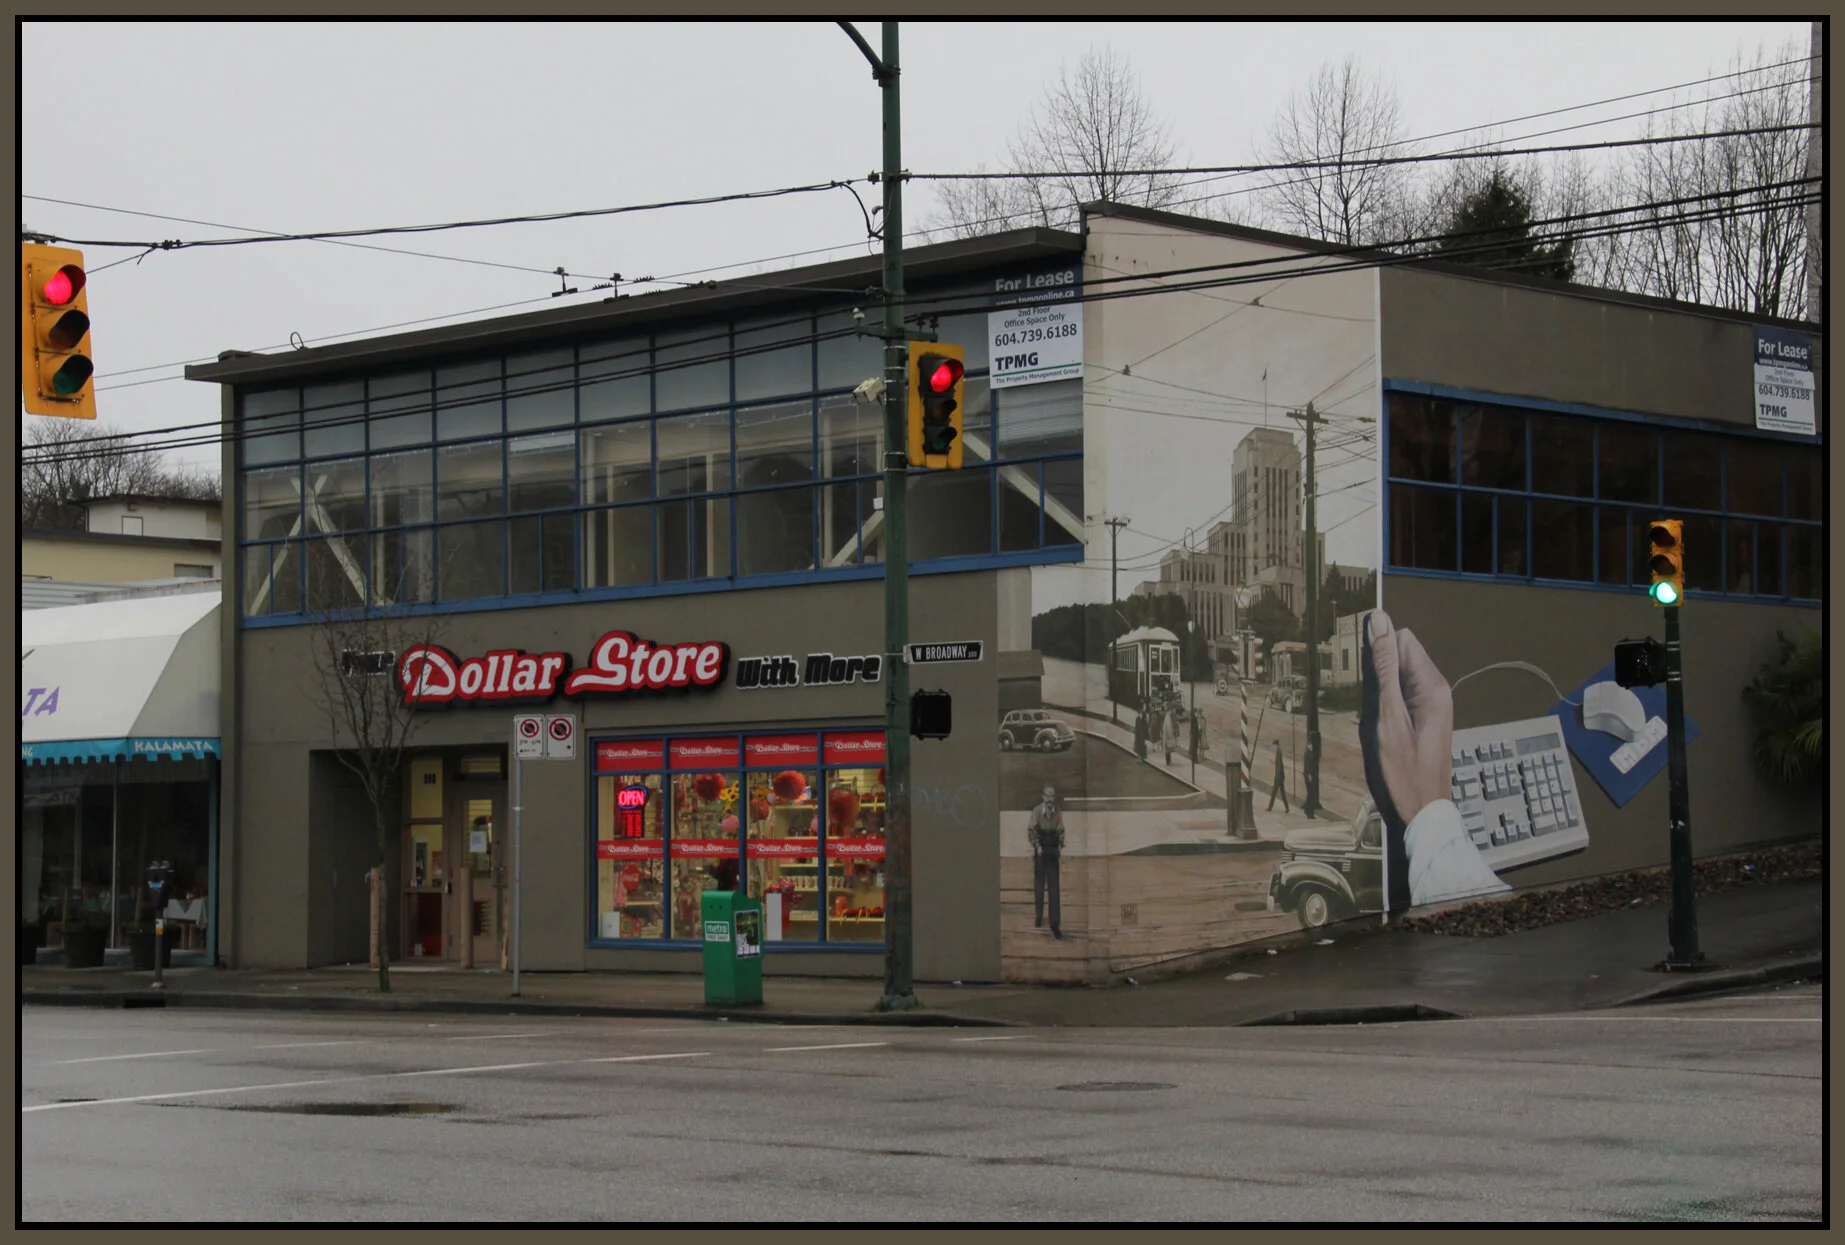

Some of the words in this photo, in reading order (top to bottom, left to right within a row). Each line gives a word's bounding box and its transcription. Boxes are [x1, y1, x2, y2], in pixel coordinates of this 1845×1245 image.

[996, 278, 1022, 292] For
[1026, 270, 1074, 288] Lease
[1018, 309, 1031, 317] 2nd
[1033, 306, 1050, 315] Floor
[1004, 319, 1025, 328] Office
[1026, 316, 1047, 326] Space
[1048, 312, 1066, 322] Only
[995, 323, 1077, 347] 604.739.6188
[1758, 338, 1775, 355] For
[1778, 341, 1808, 359] Lease
[995, 352, 1039, 370] TPMG
[1006, 375, 1028, 383] Property
[1029, 370, 1062, 380] Management
[1063, 367, 1080, 375] Group
[1758, 384, 1810, 400] 604.739.6188
[1760, 404, 1787, 417] TPMG
[915, 647, 922, 660] W
[926, 645, 967, 660] BROADWAY
[400, 647, 565, 700] Dollar
[567, 634, 722, 690] Store
[736, 655, 800, 689] With
[804, 653, 882, 687] More
[134, 740, 213, 753] KALAMATA
[618, 789, 645, 806] OPEN
[707, 924, 728, 933] metro
